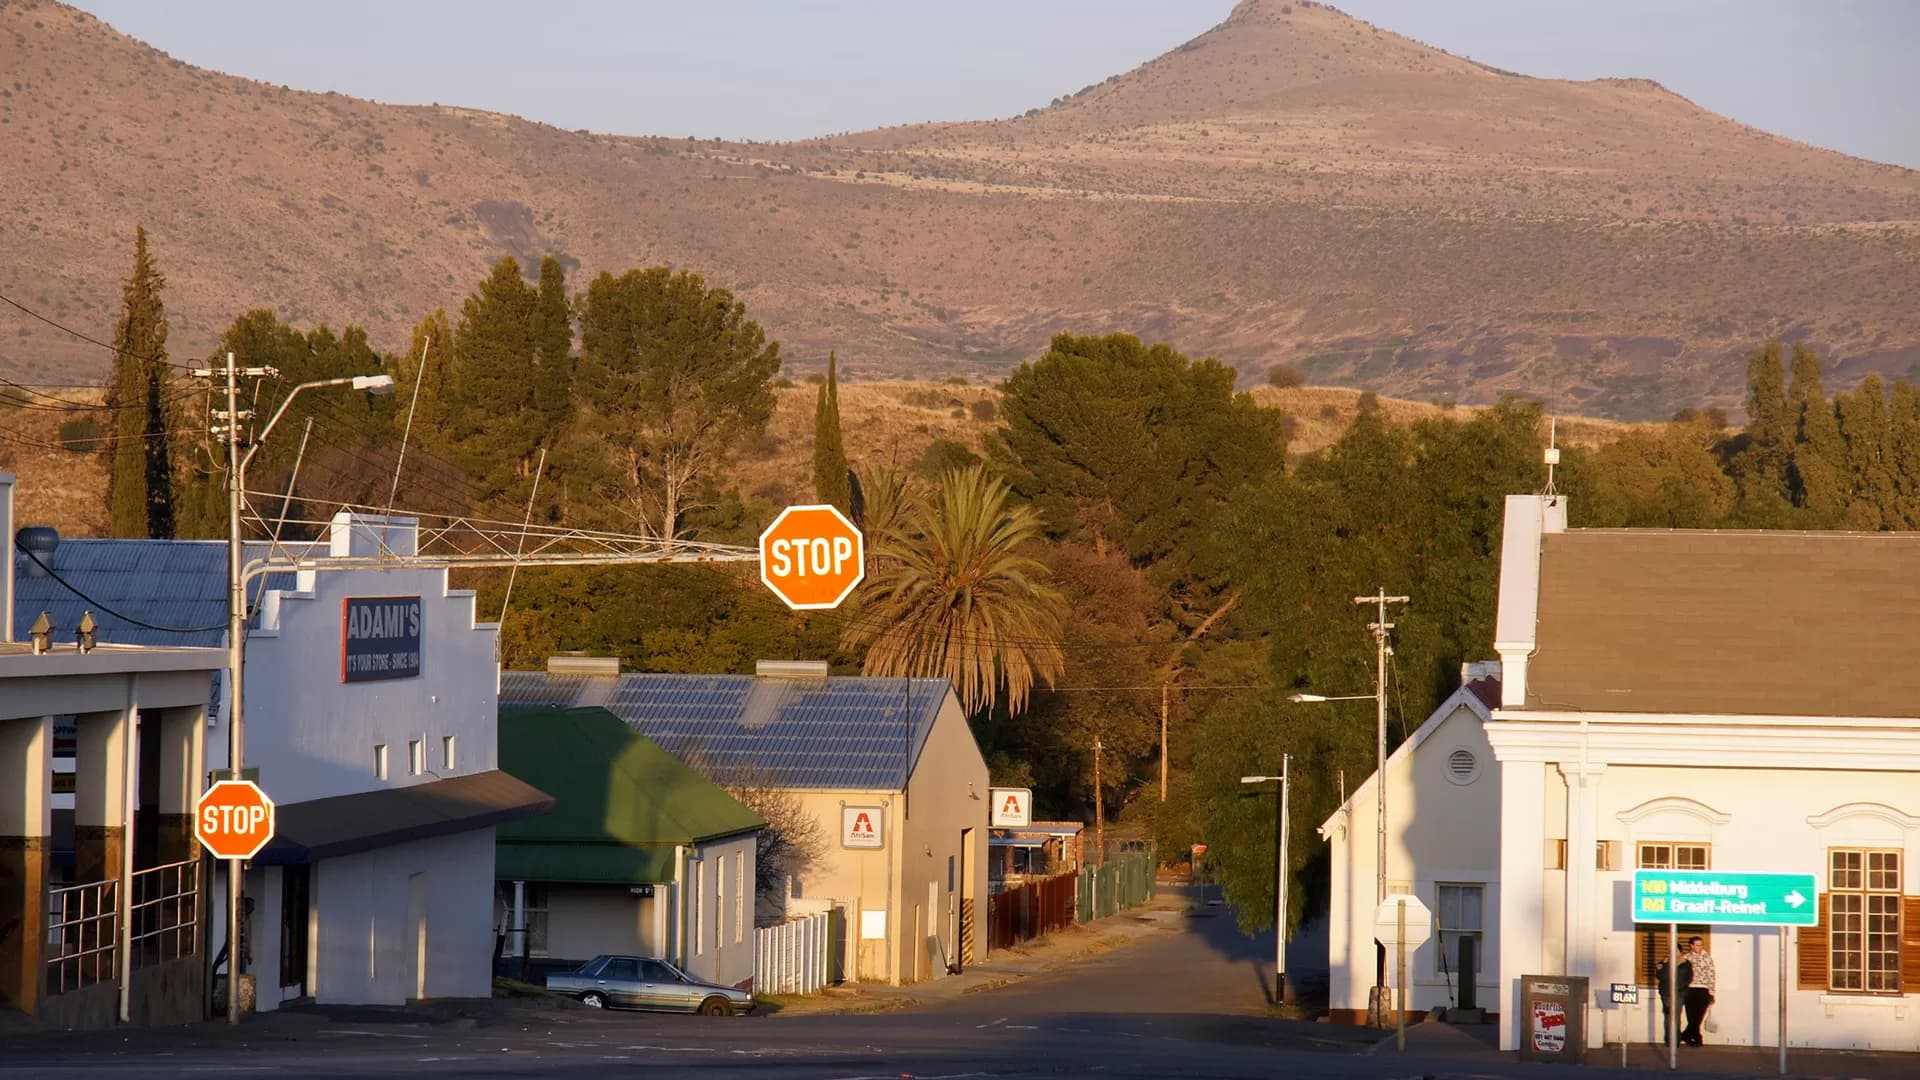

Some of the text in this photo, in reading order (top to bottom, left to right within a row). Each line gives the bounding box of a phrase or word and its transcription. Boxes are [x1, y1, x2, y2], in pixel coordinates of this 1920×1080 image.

[771, 536, 852, 577] STOP
[347, 604, 419, 639] ADAMI'S
[203, 805, 265, 834] STOP
[1670, 881, 1748, 899] Middelburg
[1670, 899, 1767, 915] Graaff-Reinet
